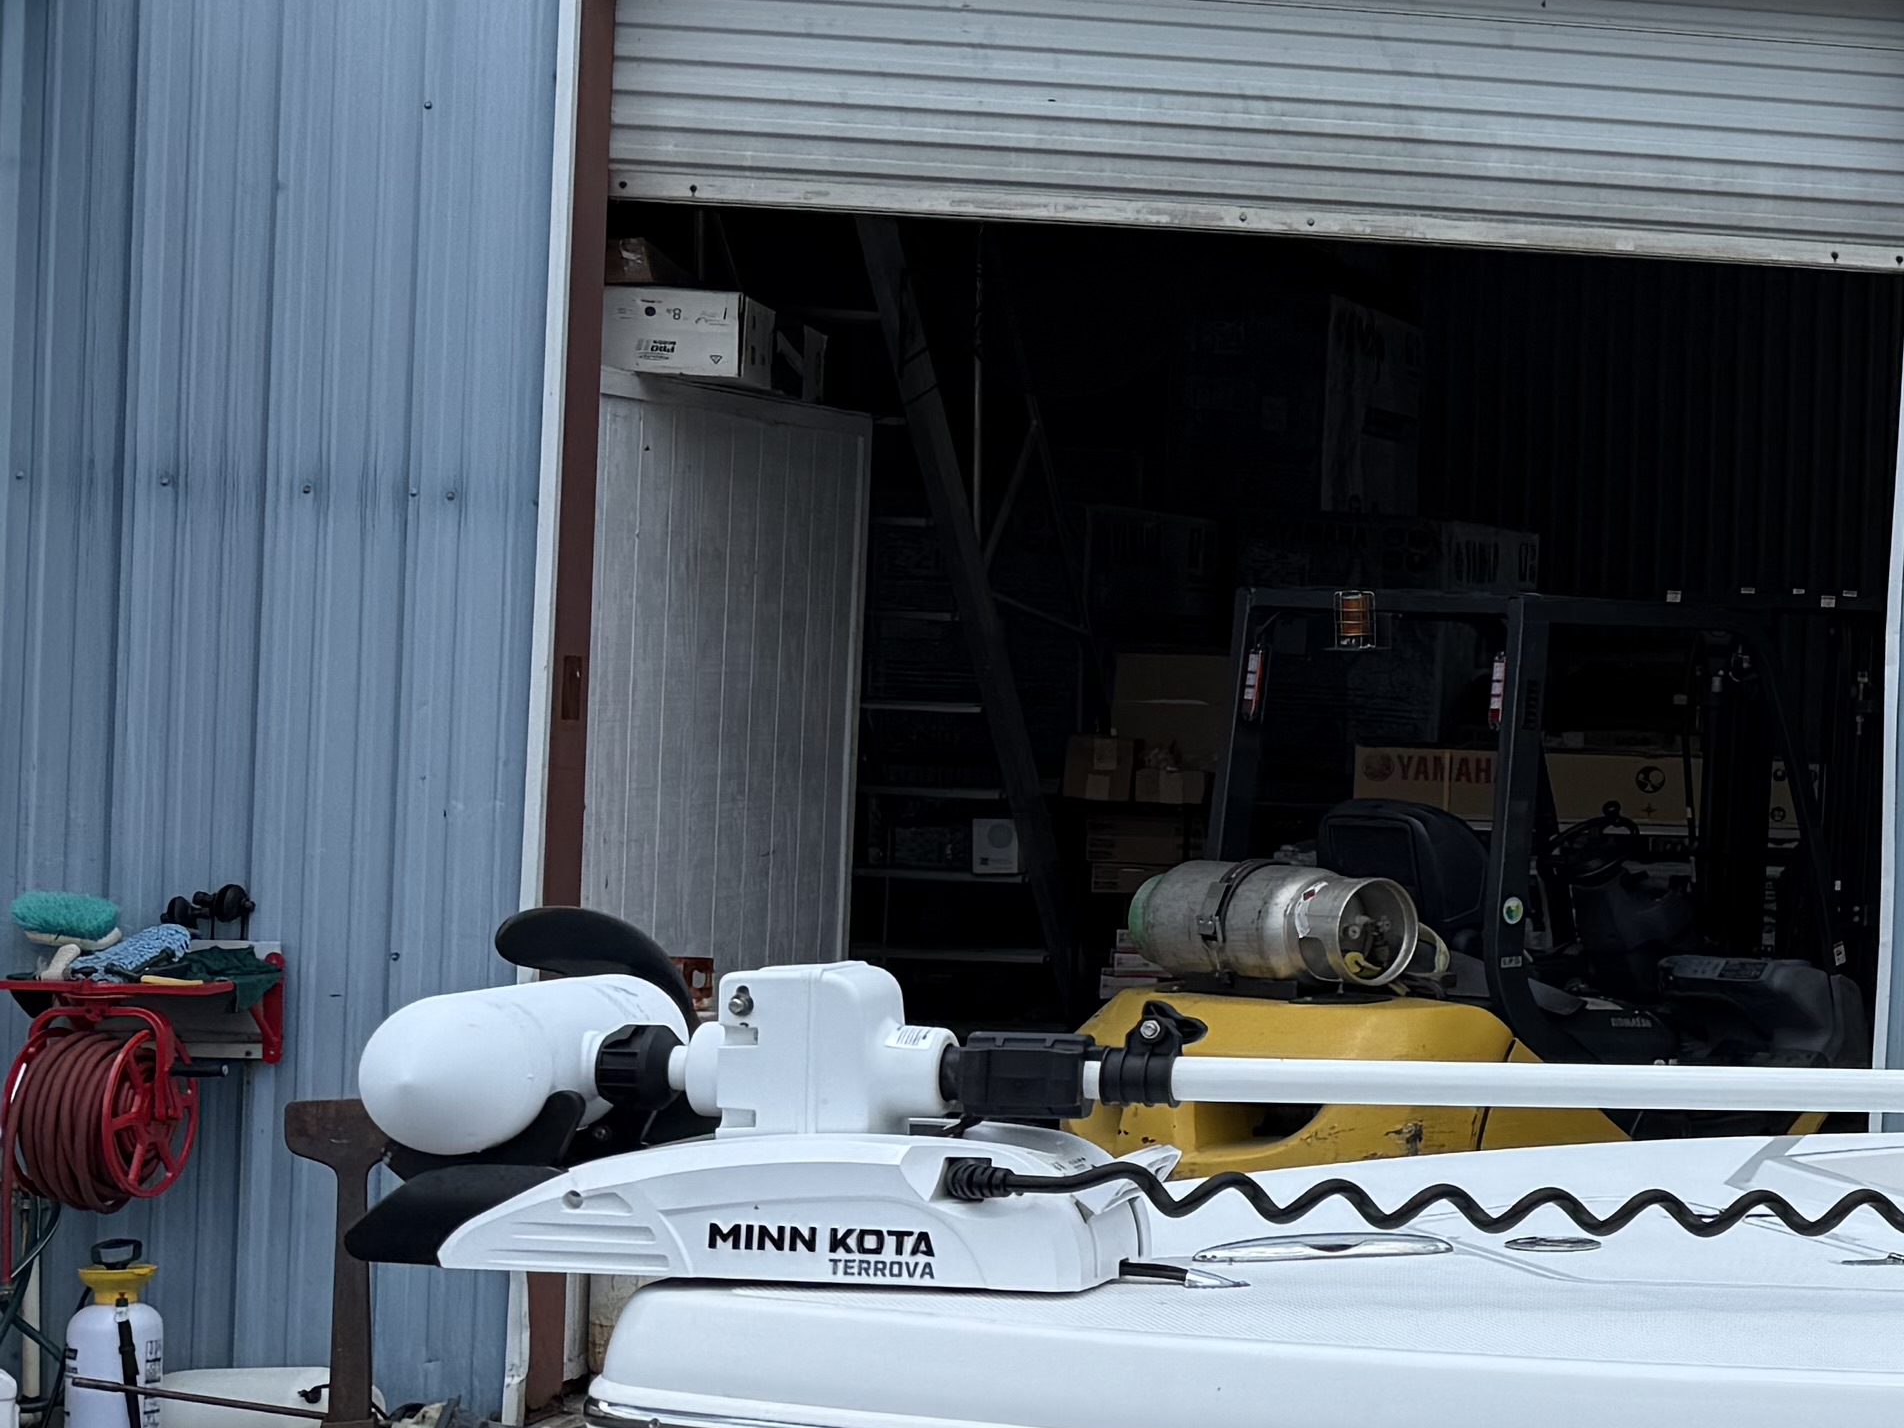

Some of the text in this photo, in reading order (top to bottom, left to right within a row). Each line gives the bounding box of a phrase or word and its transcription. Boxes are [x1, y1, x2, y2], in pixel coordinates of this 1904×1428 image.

[1397, 753, 1499, 786] YAMAH
[707, 1222, 936, 1259] MINN KOTA
[828, 1257, 936, 1280] TERROVA
